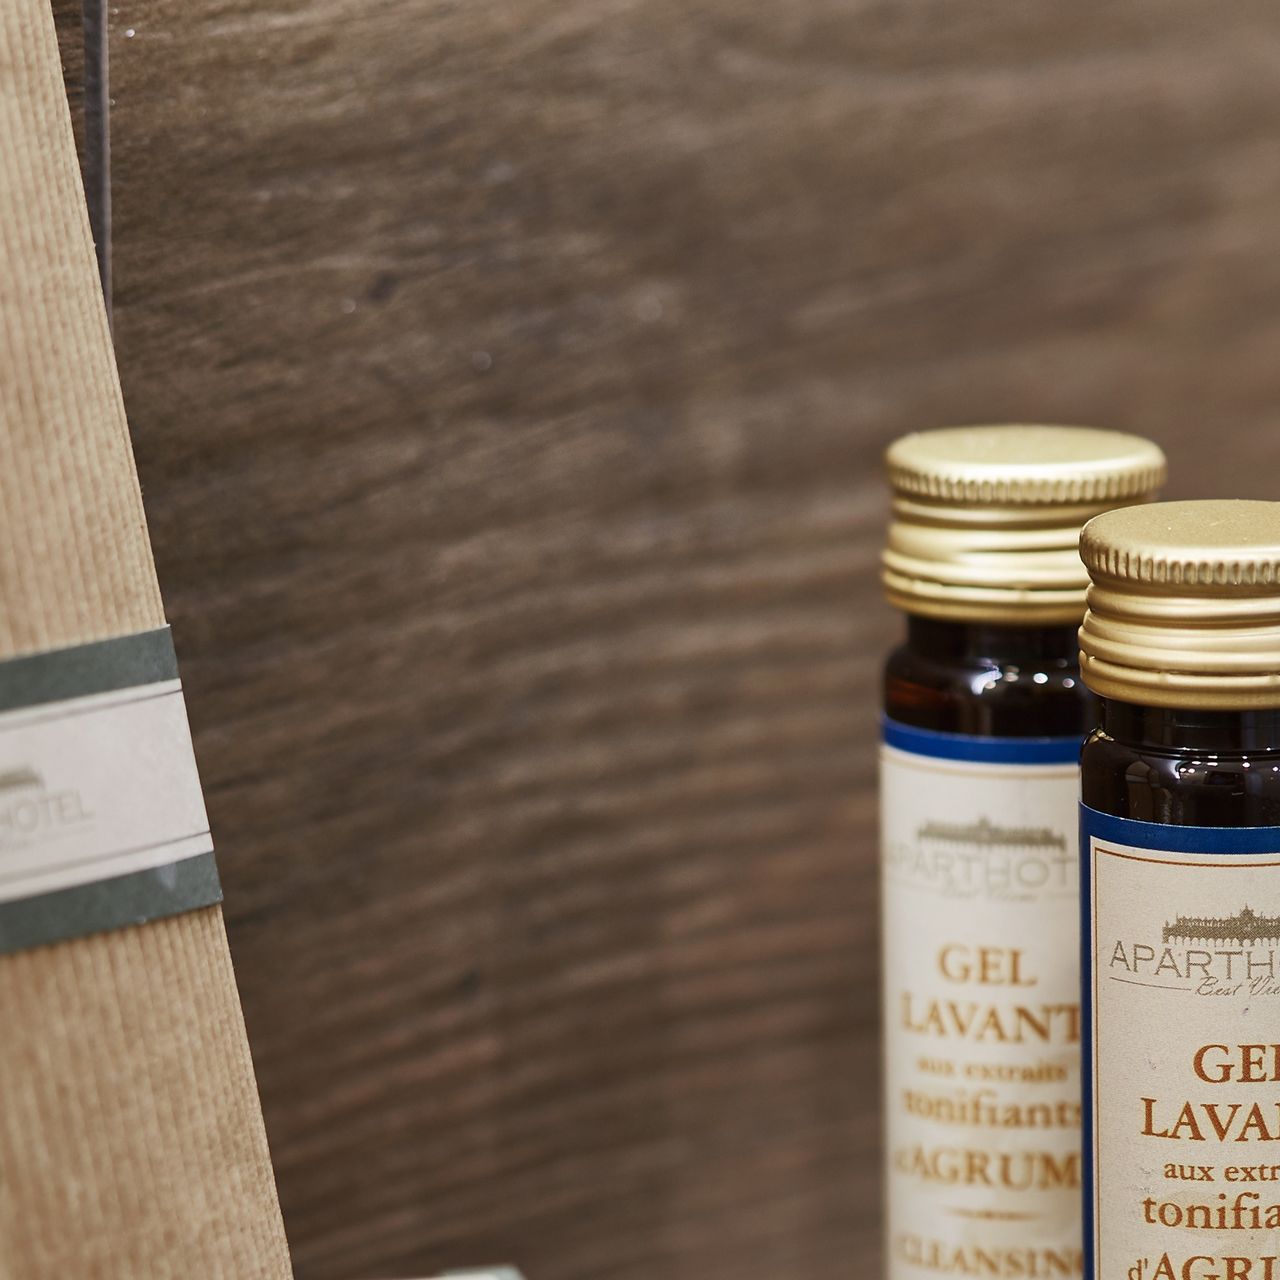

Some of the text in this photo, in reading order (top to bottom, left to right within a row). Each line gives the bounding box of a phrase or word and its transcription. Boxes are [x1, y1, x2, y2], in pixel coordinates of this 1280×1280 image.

[937, 944, 1037, 987] GEL
[1194, 976, 1243, 996] Best
[1163, 1162, 1215, 1182] aux
